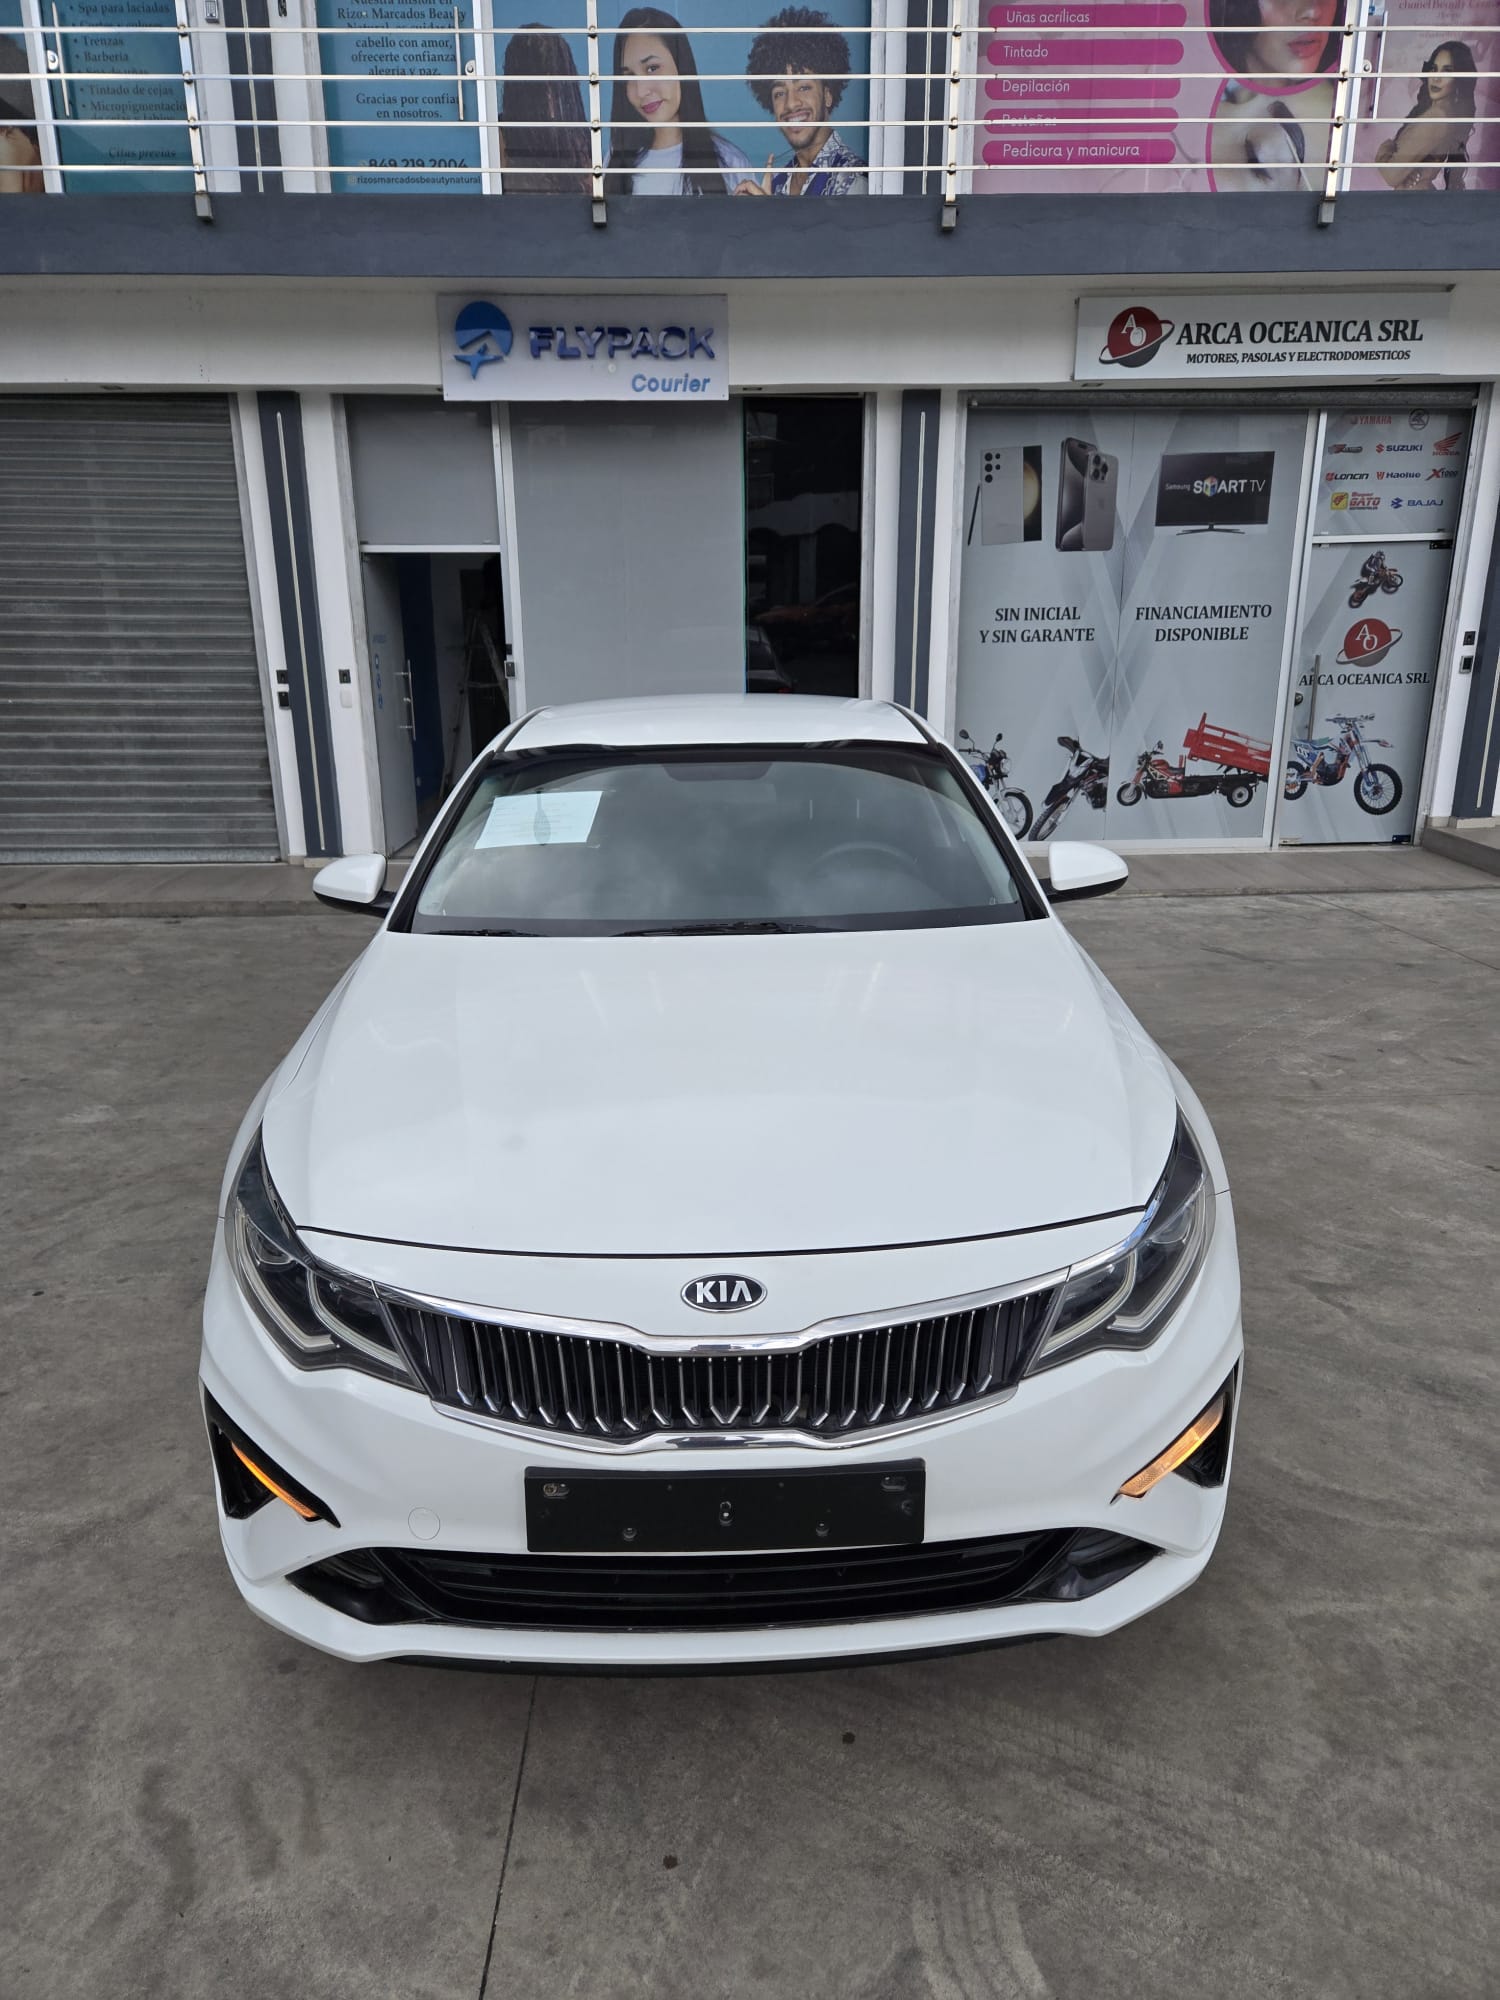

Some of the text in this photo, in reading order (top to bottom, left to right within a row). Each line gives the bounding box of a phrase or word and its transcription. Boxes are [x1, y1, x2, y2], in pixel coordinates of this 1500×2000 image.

[371, 8, 425, 19] Marcados
[429, 8, 466, 22] Beauy
[1006, 10, 1036, 23] Uñas
[356, 37, 452, 50] cabello con amor,
[352, 51, 399, 62] ofrecerte
[1003, 44, 1048, 58] Tintado
[132, 83, 144, 95] de
[1003, 79, 1070, 96] Depilación
[356, 93, 397, 104] Gracias
[401, 96, 419, 107] por
[377, 109, 442, 118] en nosotros.
[1003, 141, 1140, 160] Pedicura y manicura
[1176, 319, 1423, 345] ARCA OCEANICA SRL
[528, 326, 715, 359] FLYPACK
[1186, 350, 1411, 365] MOTORES, PASOLAS Y ELECTRODOMESTICOS
[631, 373, 711, 392] Courier
[1359, 415, 1392, 425] YAMAHA
[1386, 444, 1423, 452] SUZUKI
[1165, 482, 1191, 491] Samsung
[1249, 479, 1266, 493] TV
[995, 607, 1081, 621] SIN INICIAL
[1136, 604, 1272, 620] FINANCIAMIENTO
[979, 628, 1095, 643] Y SIN GARANTE
[1155, 626, 1249, 642] DISPONIBLE
[1337, 673, 1403, 686] OCEANICA
[1405, 672, 1430, 684] SRL
[696, 1280, 753, 1304] KIA
